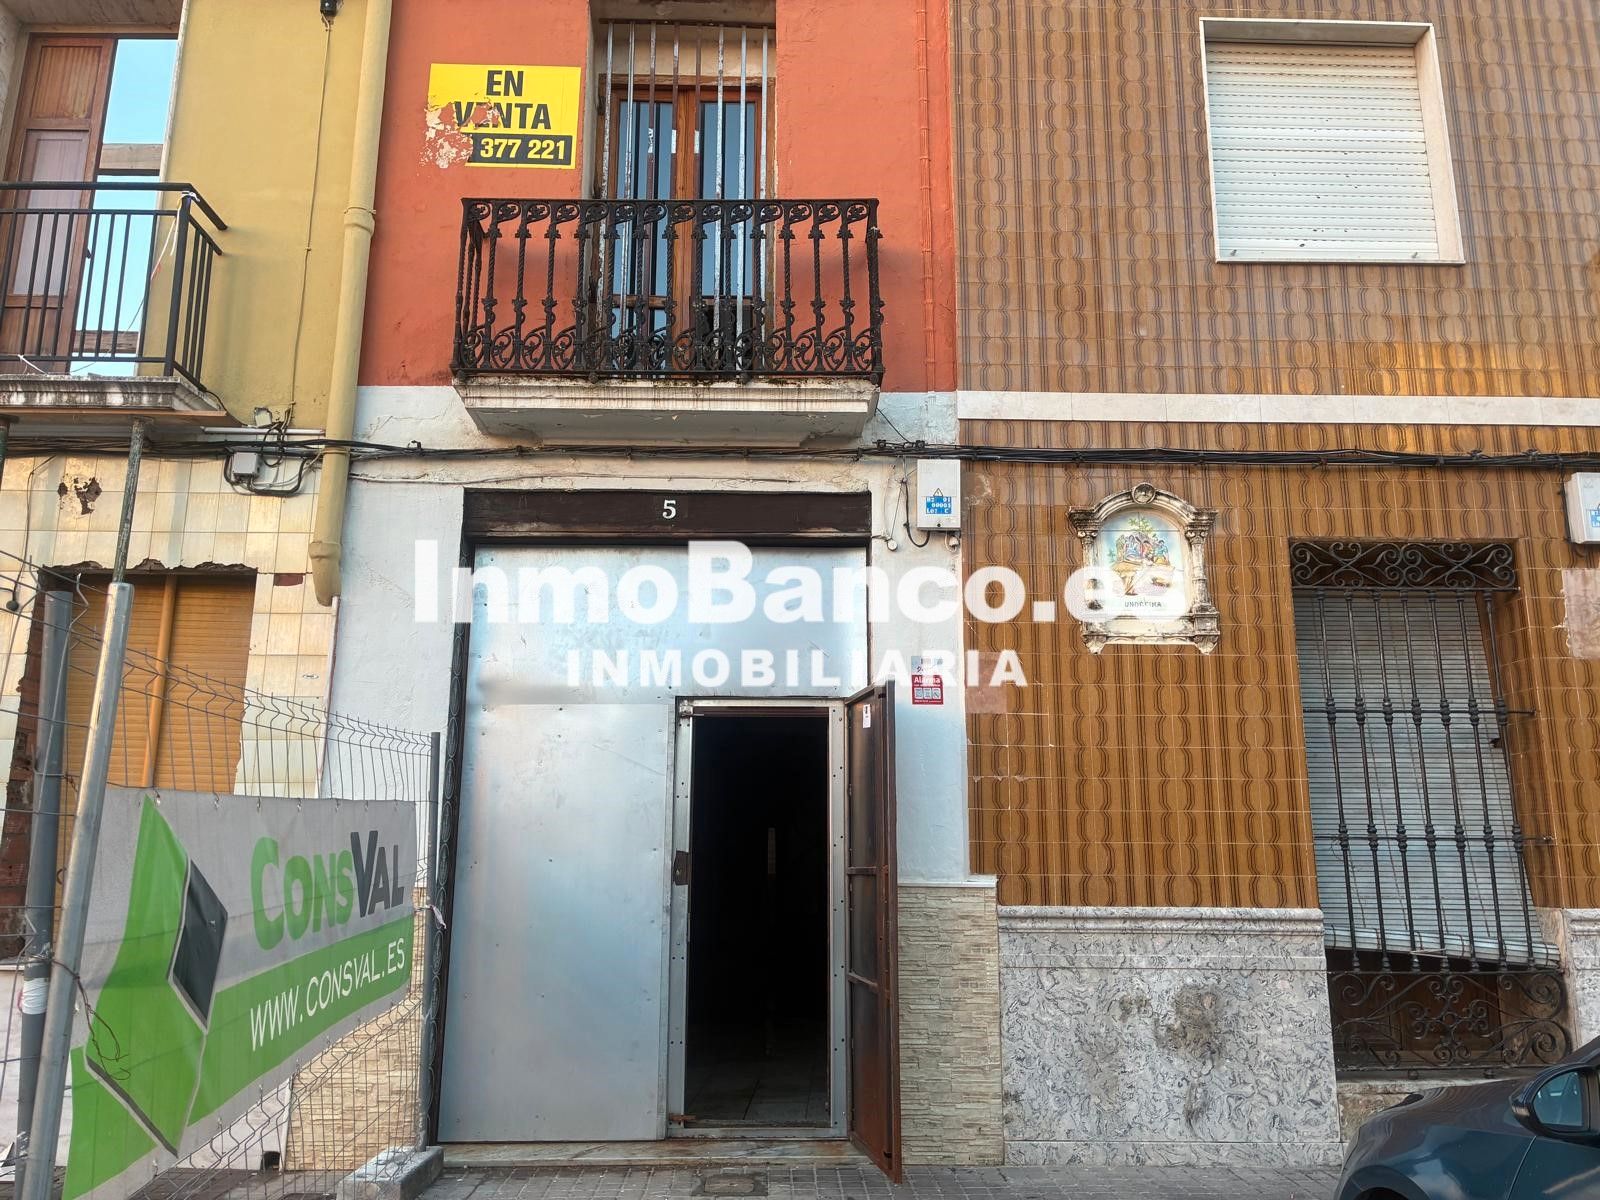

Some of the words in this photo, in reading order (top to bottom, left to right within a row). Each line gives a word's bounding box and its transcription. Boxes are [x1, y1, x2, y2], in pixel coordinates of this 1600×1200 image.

[486, 70, 524, 97] EN
[480, 138, 521, 159] 377
[527, 139, 566, 160] 221
[662, 499, 677, 519] 5
[250, 937, 405, 1052] WWW.CONSVAL.ES
